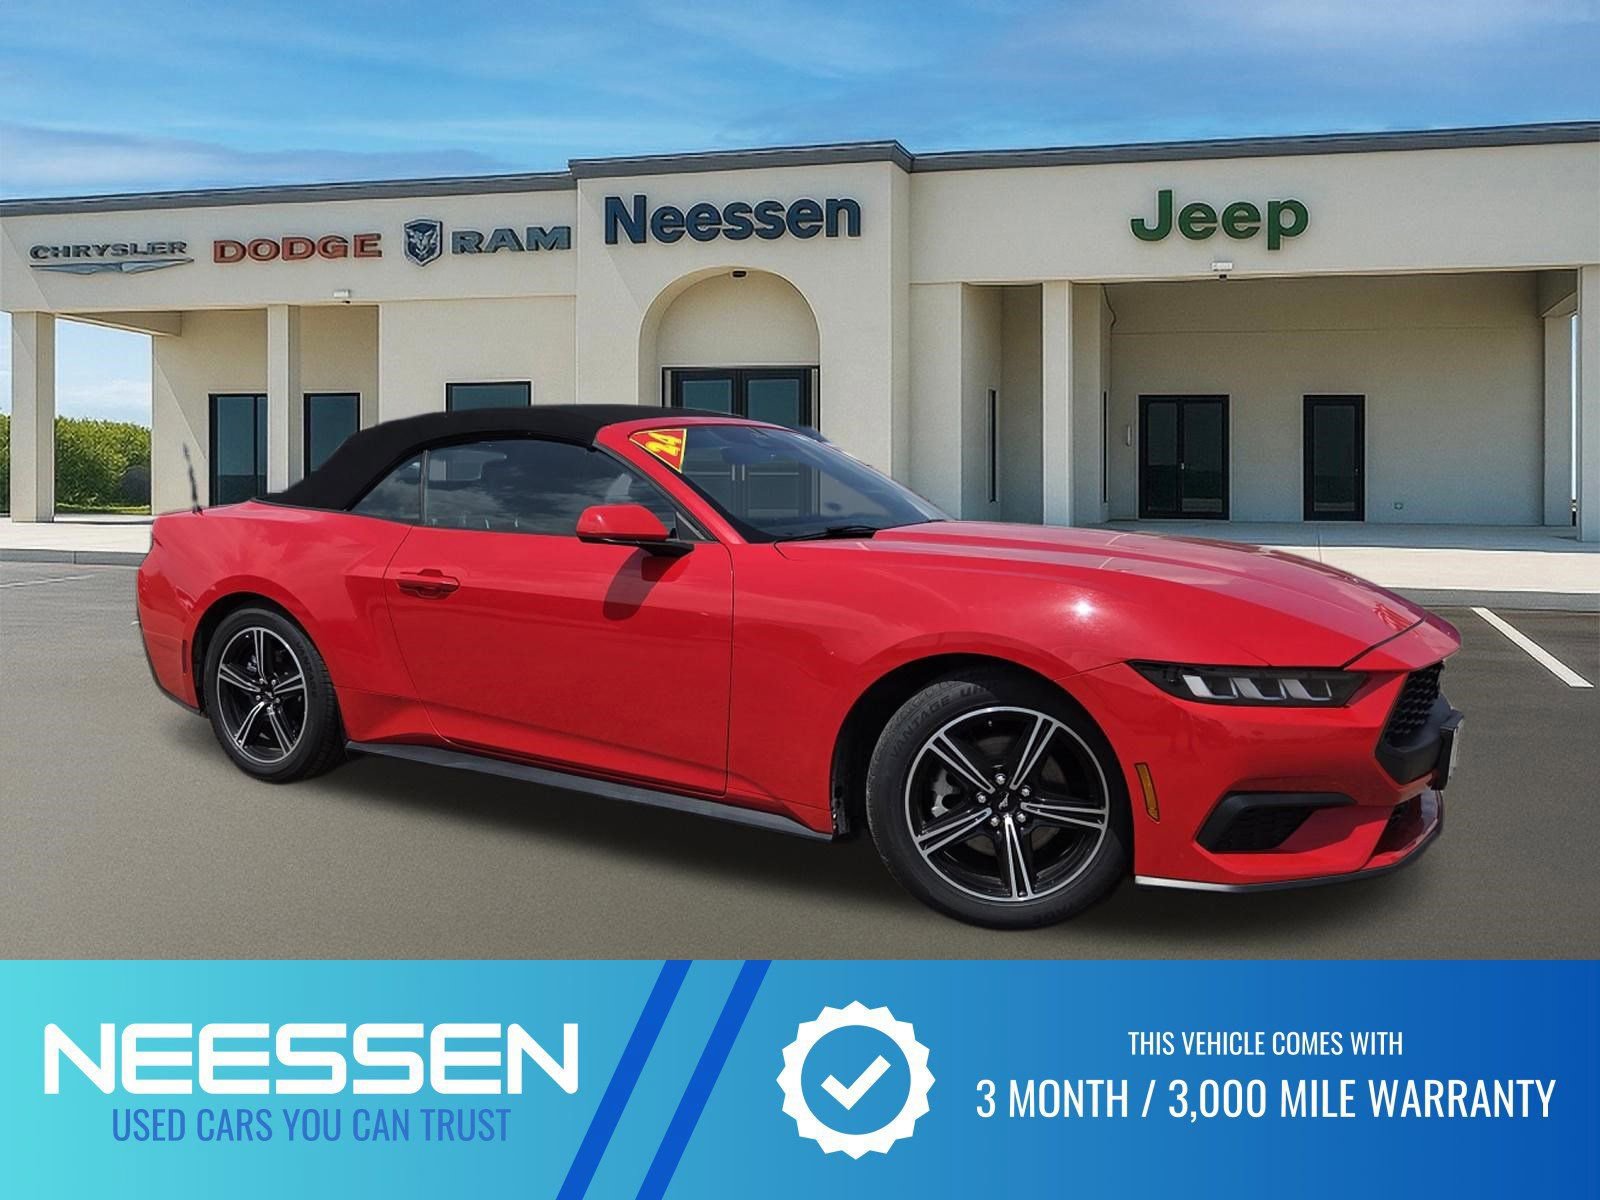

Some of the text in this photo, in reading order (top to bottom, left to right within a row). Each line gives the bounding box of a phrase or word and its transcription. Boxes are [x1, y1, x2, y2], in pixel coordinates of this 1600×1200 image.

[604, 195, 862, 244] Neessen
[1130, 190, 1309, 250] Jeep
[30, 240, 188, 260] CHRYSLER
[213, 233, 383, 264] DODGE
[451, 226, 572, 254] RAM
[645, 431, 682, 457] 24
[889, 695, 951, 761] VANTAGE
